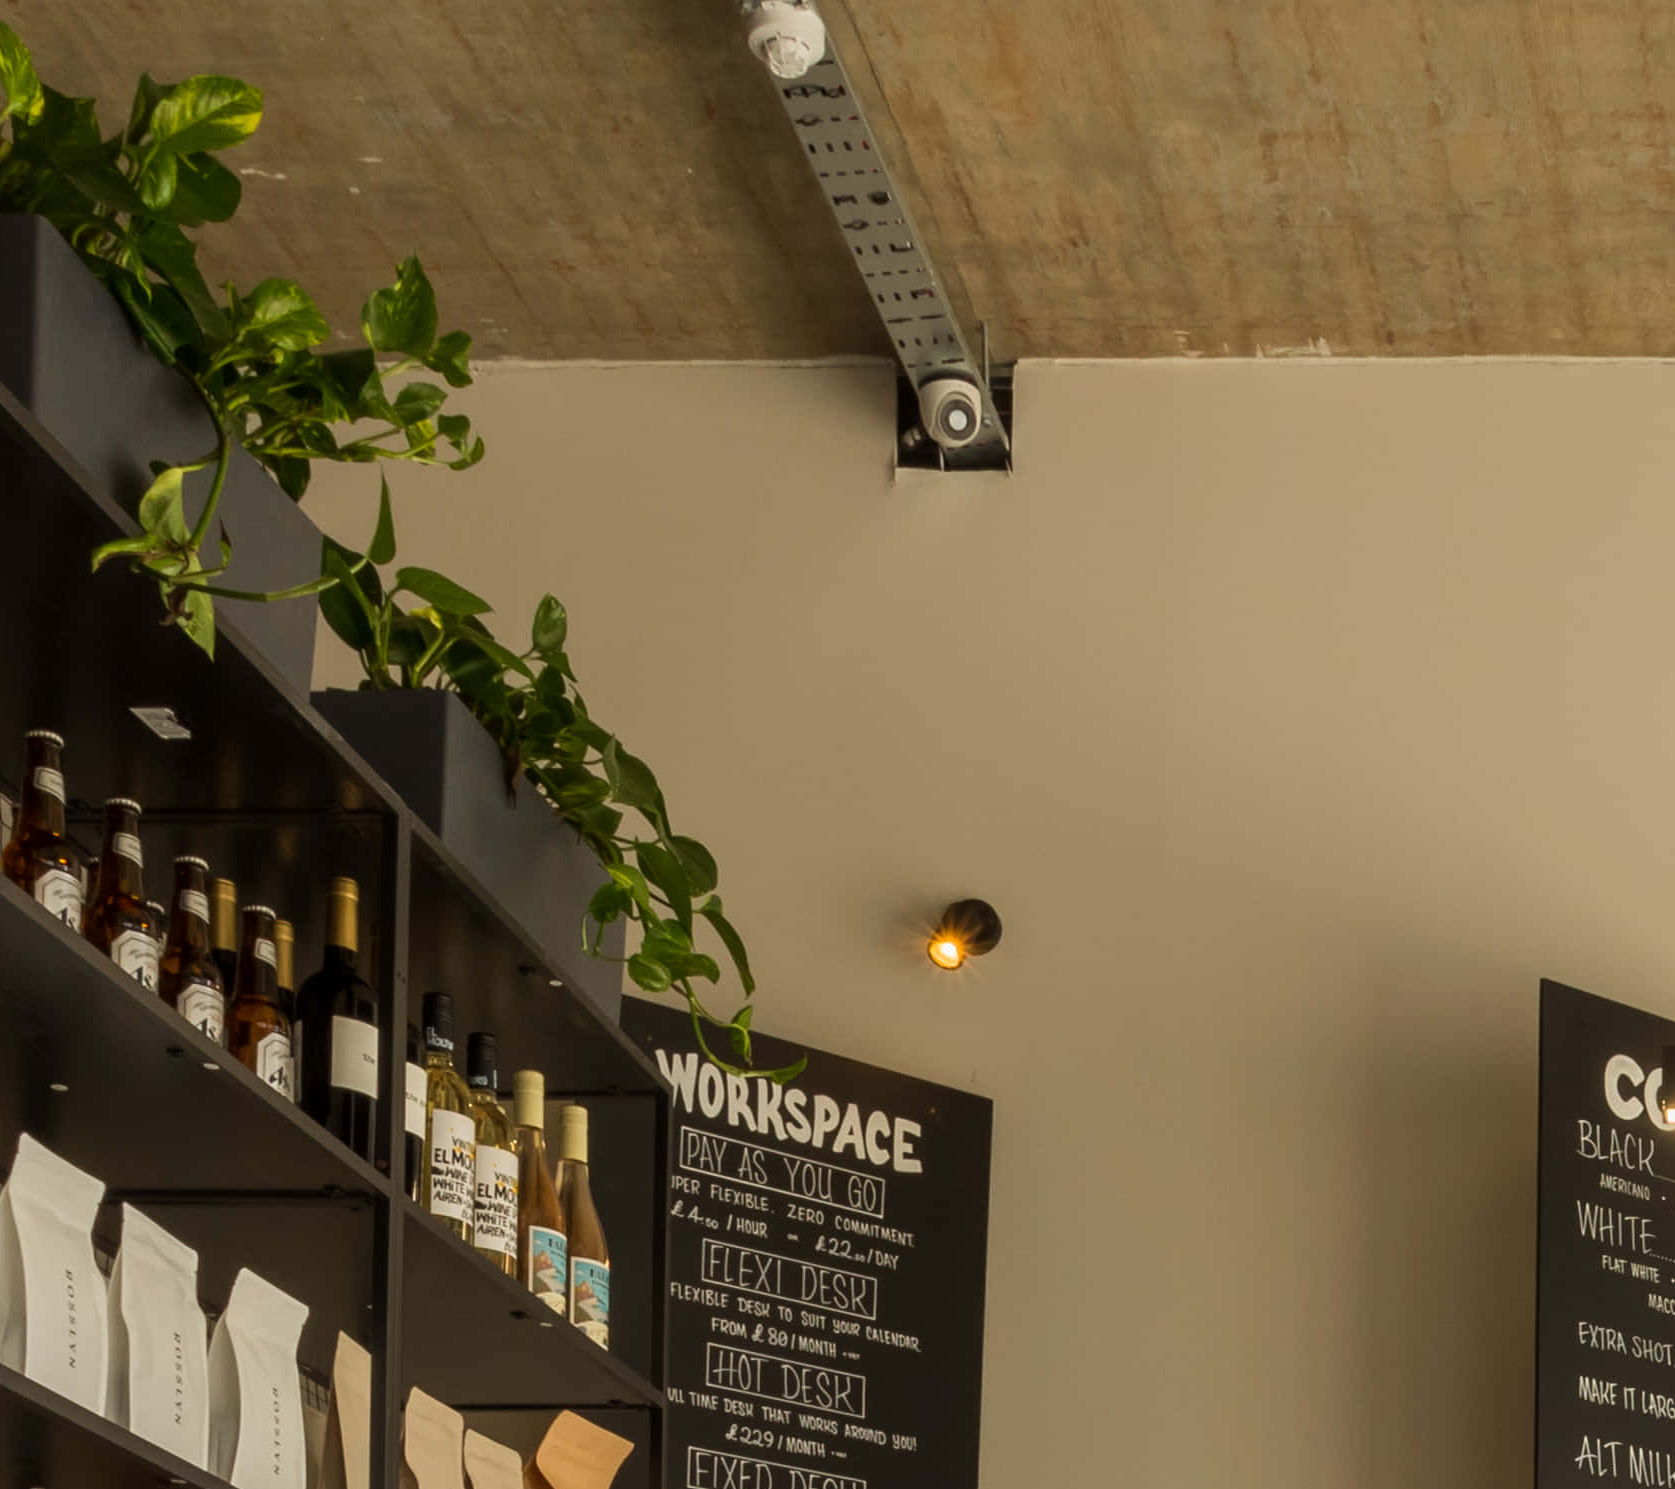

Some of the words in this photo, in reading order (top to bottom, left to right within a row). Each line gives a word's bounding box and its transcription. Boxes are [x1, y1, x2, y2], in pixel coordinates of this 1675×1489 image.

[655, 1049, 923, 1174] WORKSPACE
[687, 1132, 727, 1174] PAY
[739, 1147, 768, 1184] AS
[784, 1157, 833, 1202] YOU
[848, 1176, 877, 1212] GO
[1576, 1119, 1655, 1177] BLACK
[787, 1203, 825, 1225] ZERO
[1599, 1173, 1651, 1201] AMERICANO
[1576, 1199, 1657, 1256] WHITE
[709, 1243, 782, 1295] FLEXI
[801, 1264, 868, 1316] DESK
[1601, 1254, 1629, 1274] FLAT
[1630, 1262, 1661, 1283] WHITE
[670, 1282, 729, 1309] FLEXIBLE
[738, 1297, 770, 1318] DESK
[778, 1305, 793, 1322] TO
[801, 1310, 826, 1330] SUIT
[833, 1318, 860, 1337] YOUR
[711, 1317, 747, 1339] FROM
[1578, 1321, 1626, 1354] EXTRA
[1631, 1335, 1674, 1366] SHOT
[712, 1350, 770, 1393] HOT
[781, 1364, 856, 1413] DESK
[1578, 1375, 1618, 1406] MAKE
[1623, 1386, 1637, 1411] IT
[667, 1387, 686, 1405] ULL
[689, 1391, 718, 1411] TIME
[724, 1397, 754, 1418] DESK
[762, 1405, 791, 1426] THAT
[799, 1413, 838, 1436] WORKS
[844, 1423, 887, 1447] AROUND
[1575, 1434, 1624, 1478] ALT
